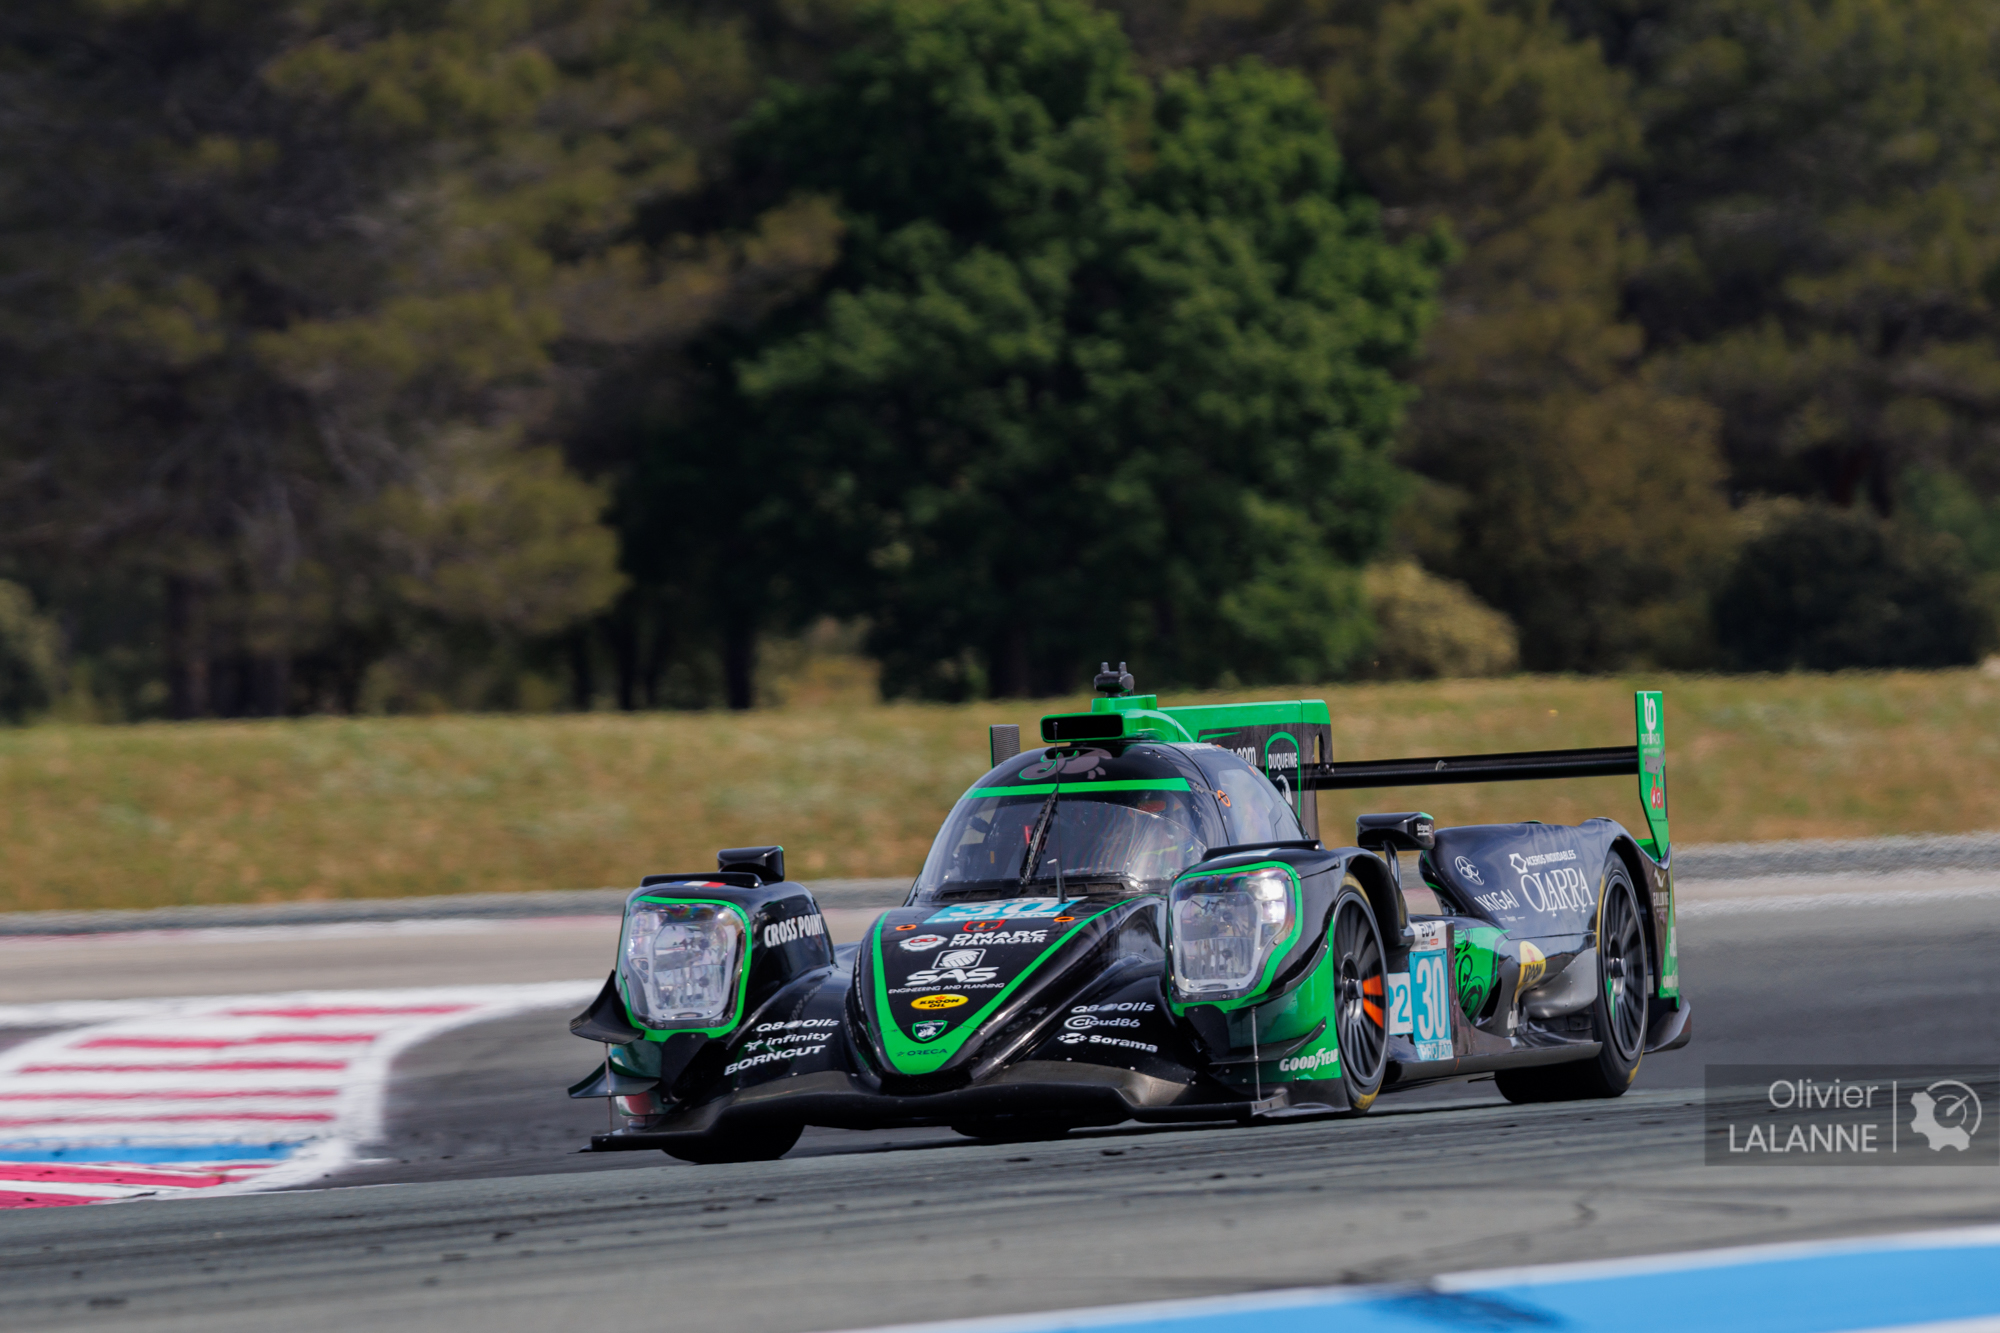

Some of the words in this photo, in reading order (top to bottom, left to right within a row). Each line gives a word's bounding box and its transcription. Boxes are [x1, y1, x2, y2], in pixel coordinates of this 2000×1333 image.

[1268, 752, 1298, 771] DUQUEINE
[1526, 854, 1547, 867] ACEROS
[949, 901, 1060, 917] 30
[1474, 888, 1521, 913] IKIGAI
[763, 917, 798, 949] CROSS
[797, 913, 825, 940] POINT
[953, 929, 1049, 941] DMARC
[949, 936, 1046, 948] MANAGER
[904, 966, 1000, 987] SAS
[888, 985, 941, 995] ENGINEERING
[963, 982, 1006, 990] PLANNING
[919, 998, 960, 1006] KROON
[1416, 956, 1447, 1041] 30
[1064, 1014, 1141, 1030] Cloud86
[766, 1032, 833, 1047] infinity
[1088, 1034, 1159, 1053] Sorama
[724, 1044, 827, 1077] BORNCUT
[1279, 1047, 1339, 1072] GOODYEAR
